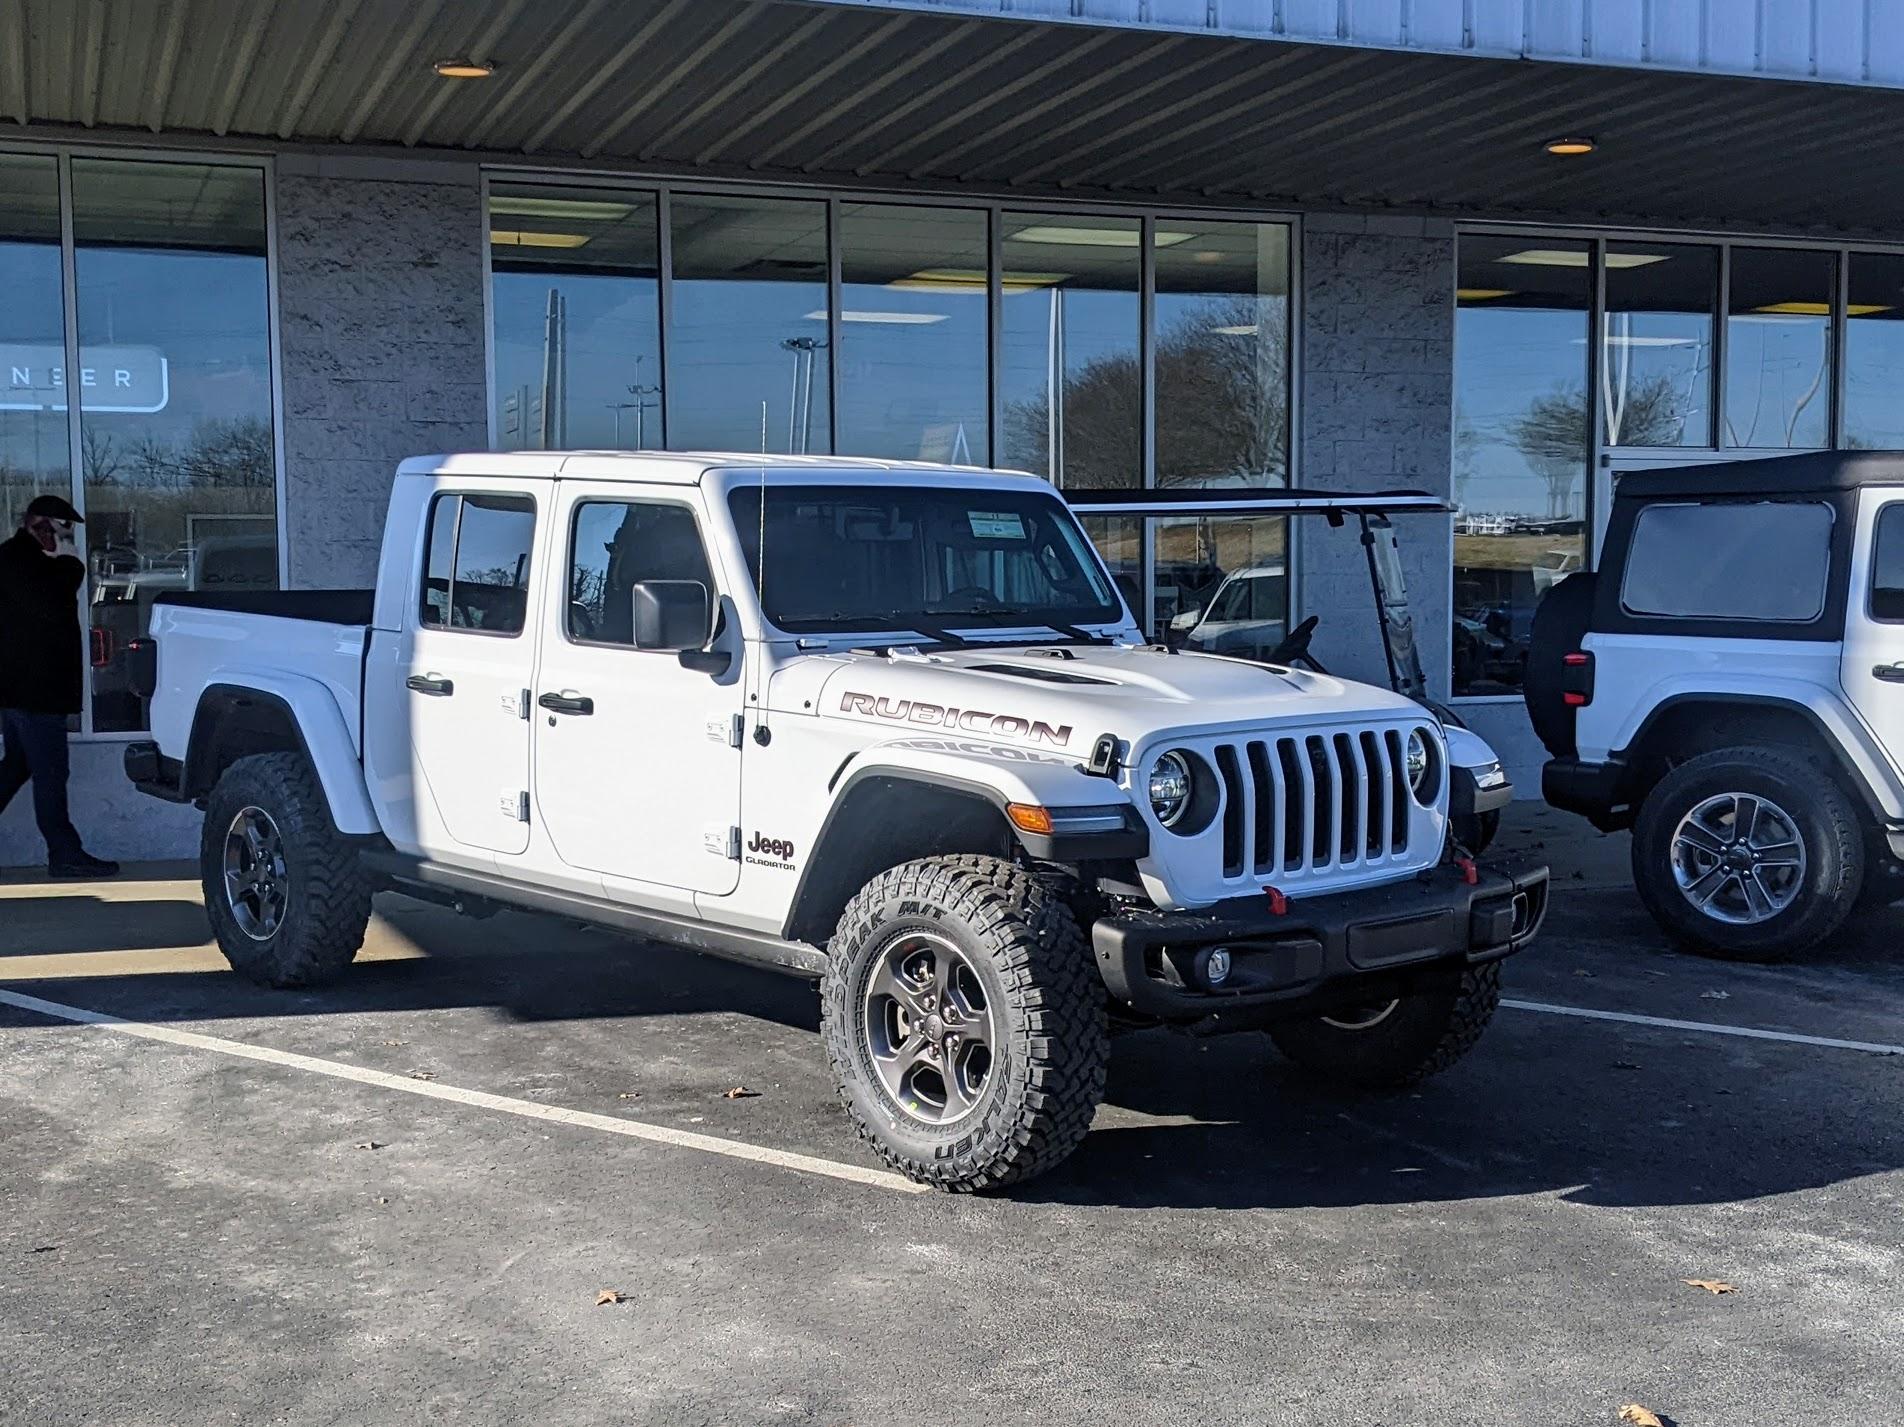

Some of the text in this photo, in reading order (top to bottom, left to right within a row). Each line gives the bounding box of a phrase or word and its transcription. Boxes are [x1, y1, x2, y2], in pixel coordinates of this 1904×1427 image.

[839, 691, 1074, 747] RUBICON
[747, 830, 794, 861] Jeep
[745, 856, 796, 871] GLADIATOR
[897, 901, 948, 920] M/T
